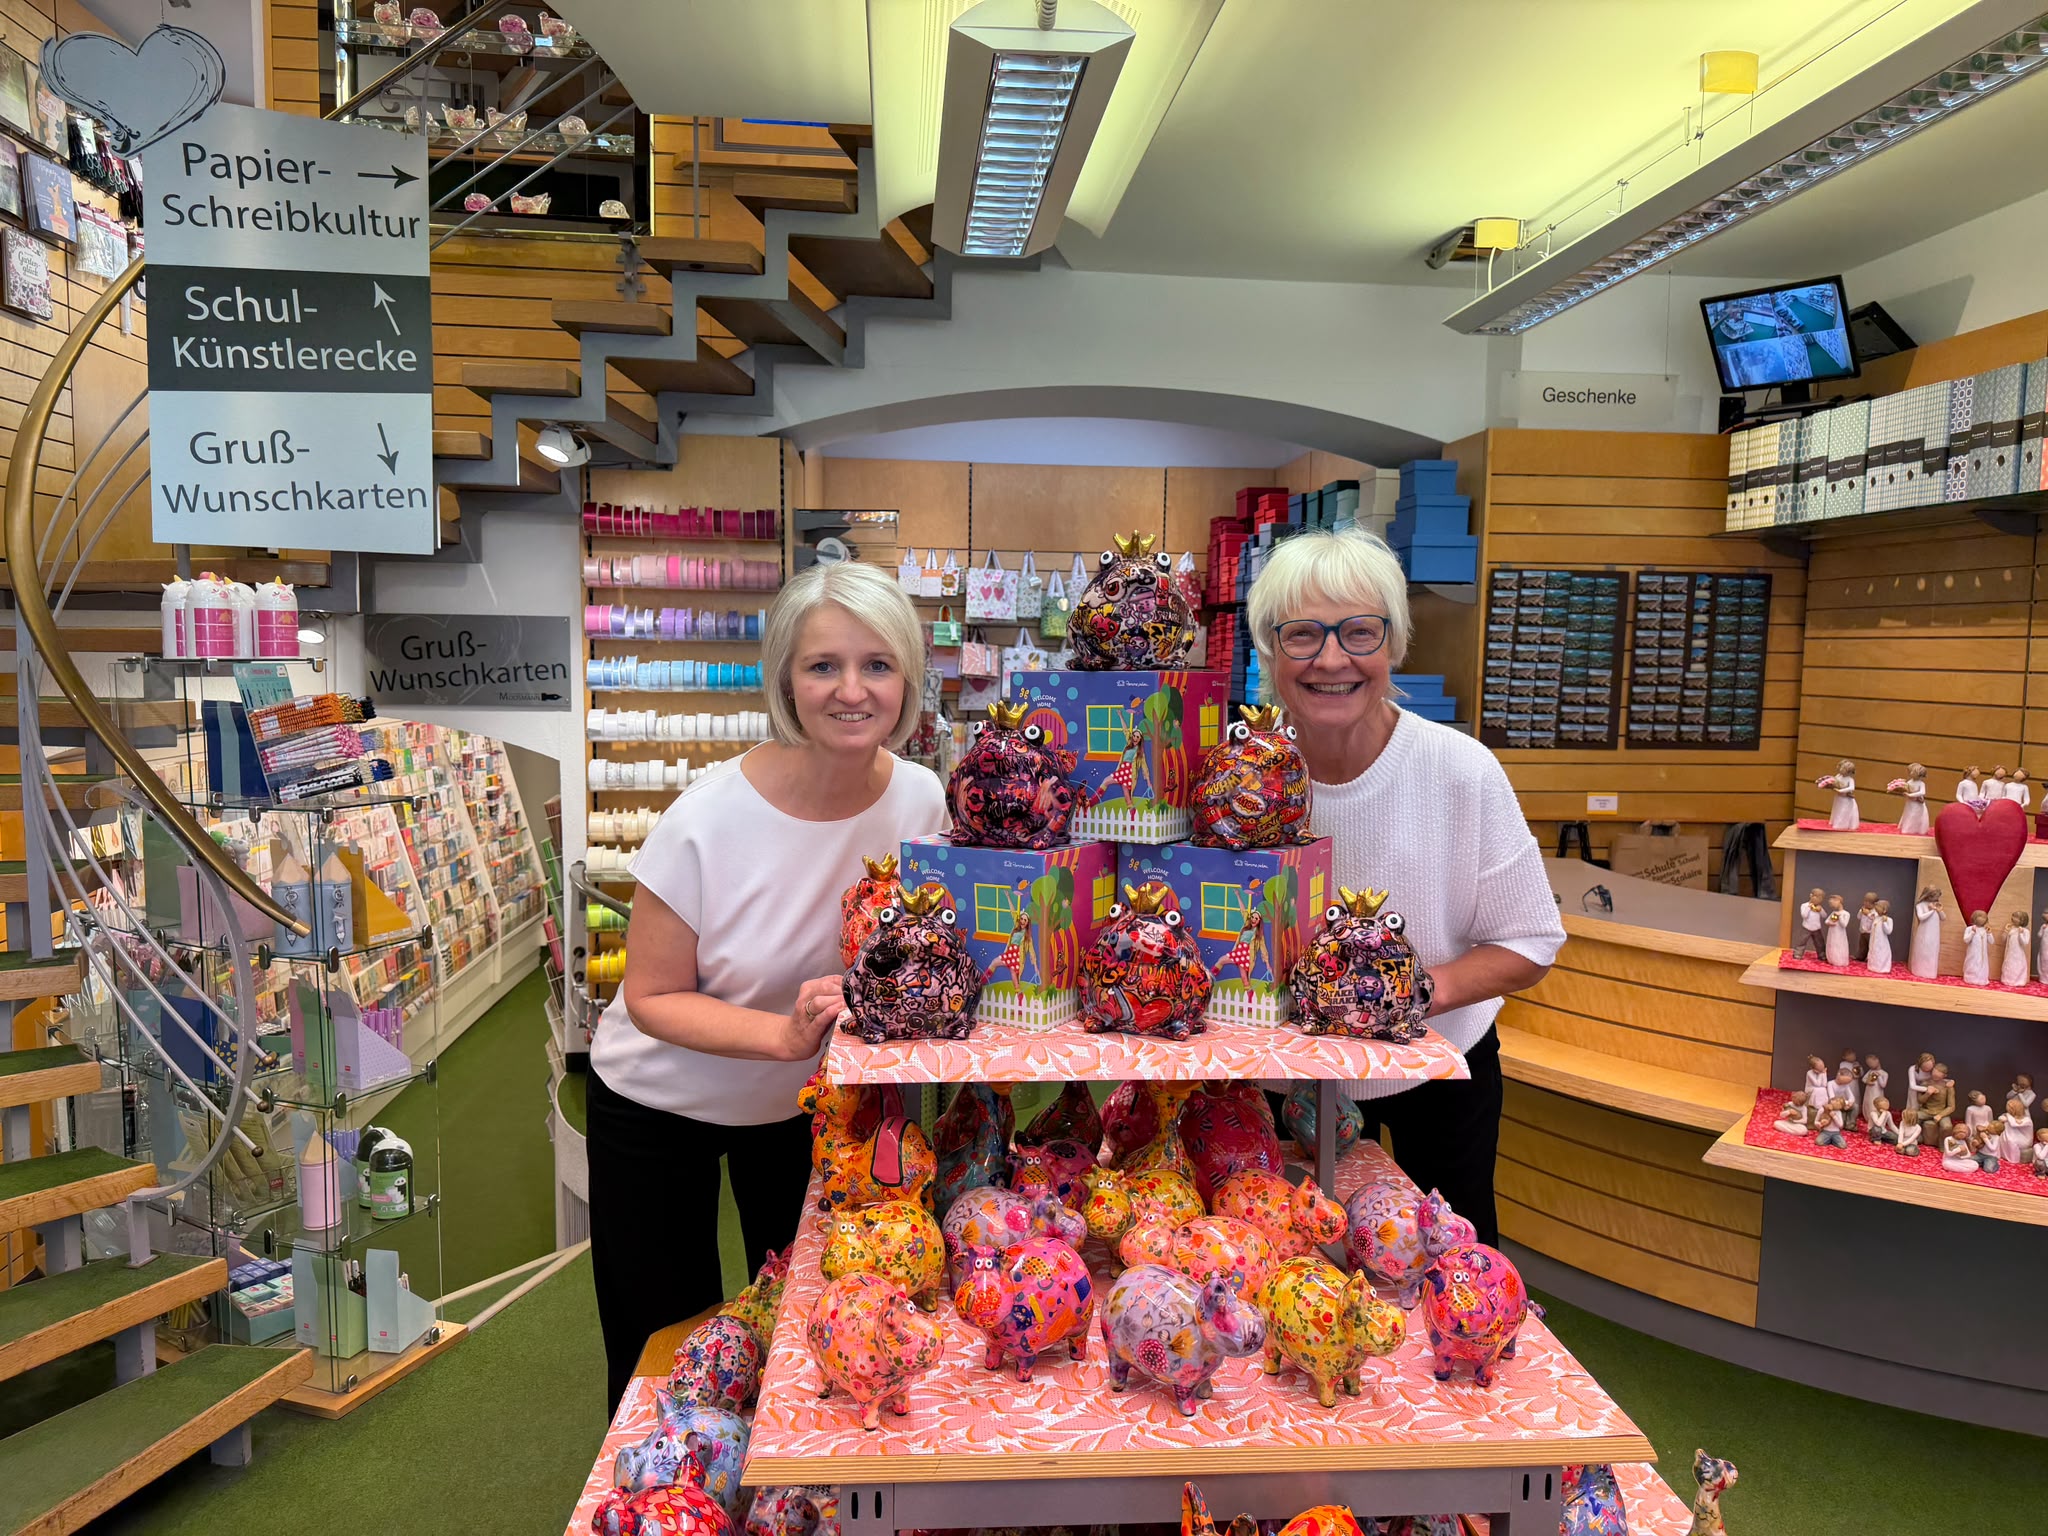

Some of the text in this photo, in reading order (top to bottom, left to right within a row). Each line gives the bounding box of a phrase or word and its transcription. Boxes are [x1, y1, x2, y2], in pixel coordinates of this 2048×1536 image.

[182, 142, 331, 189] Papier-
[162, 193, 420, 239] Schreibkultur
[184, 286, 318, 323] Schul-
[172, 336, 417, 372] Künstlerecke
[1542, 386, 1637, 405] Geschenke
[189, 429, 310, 465] Gruß-
[161, 480, 428, 514] Wunschkarten
[401, 630, 487, 661] Gruß-
[370, 661, 568, 693] Wunschkarten
[1032, 694, 1057, 703] WELCOME
[921, 868, 945, 878] WELCOME
[1142, 866, 1169, 877] WELCOME
[1147, 874, 1163, 882] HOME
[1643, 859, 1677, 878] Schule
[1671, 869, 1702, 885] Scolaire
